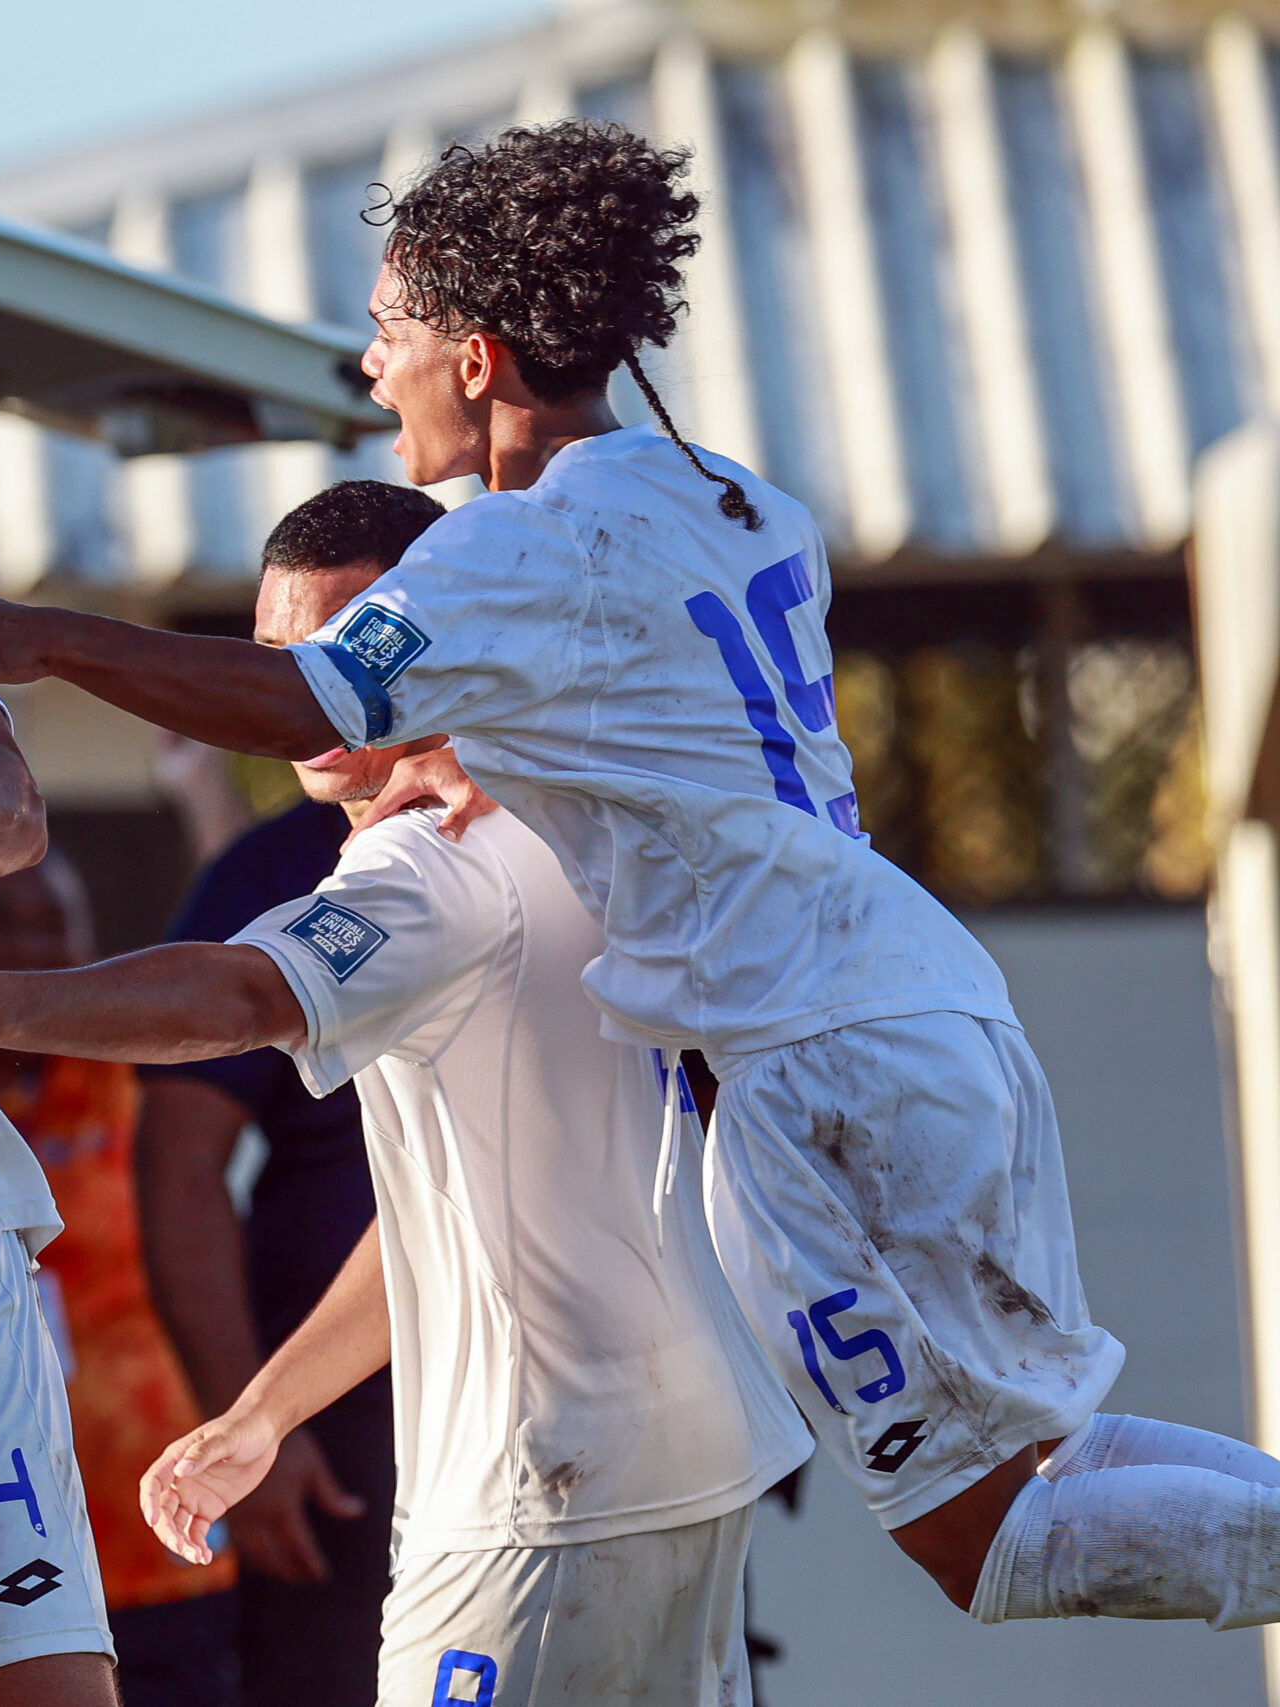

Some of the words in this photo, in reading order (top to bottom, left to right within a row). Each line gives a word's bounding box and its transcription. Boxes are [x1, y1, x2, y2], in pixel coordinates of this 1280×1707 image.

[349, 636, 365, 654] the
[359, 625, 400, 659] UNITES
[368, 617, 406, 649] FOOTBALL
[684, 549, 859, 839] 15
[309, 922, 325, 934] the
[325, 931, 355, 956] World
[318, 916, 361, 946] UNITES
[325, 911, 366, 939] FOOTBALL
[787, 1288, 906, 1415] 15
